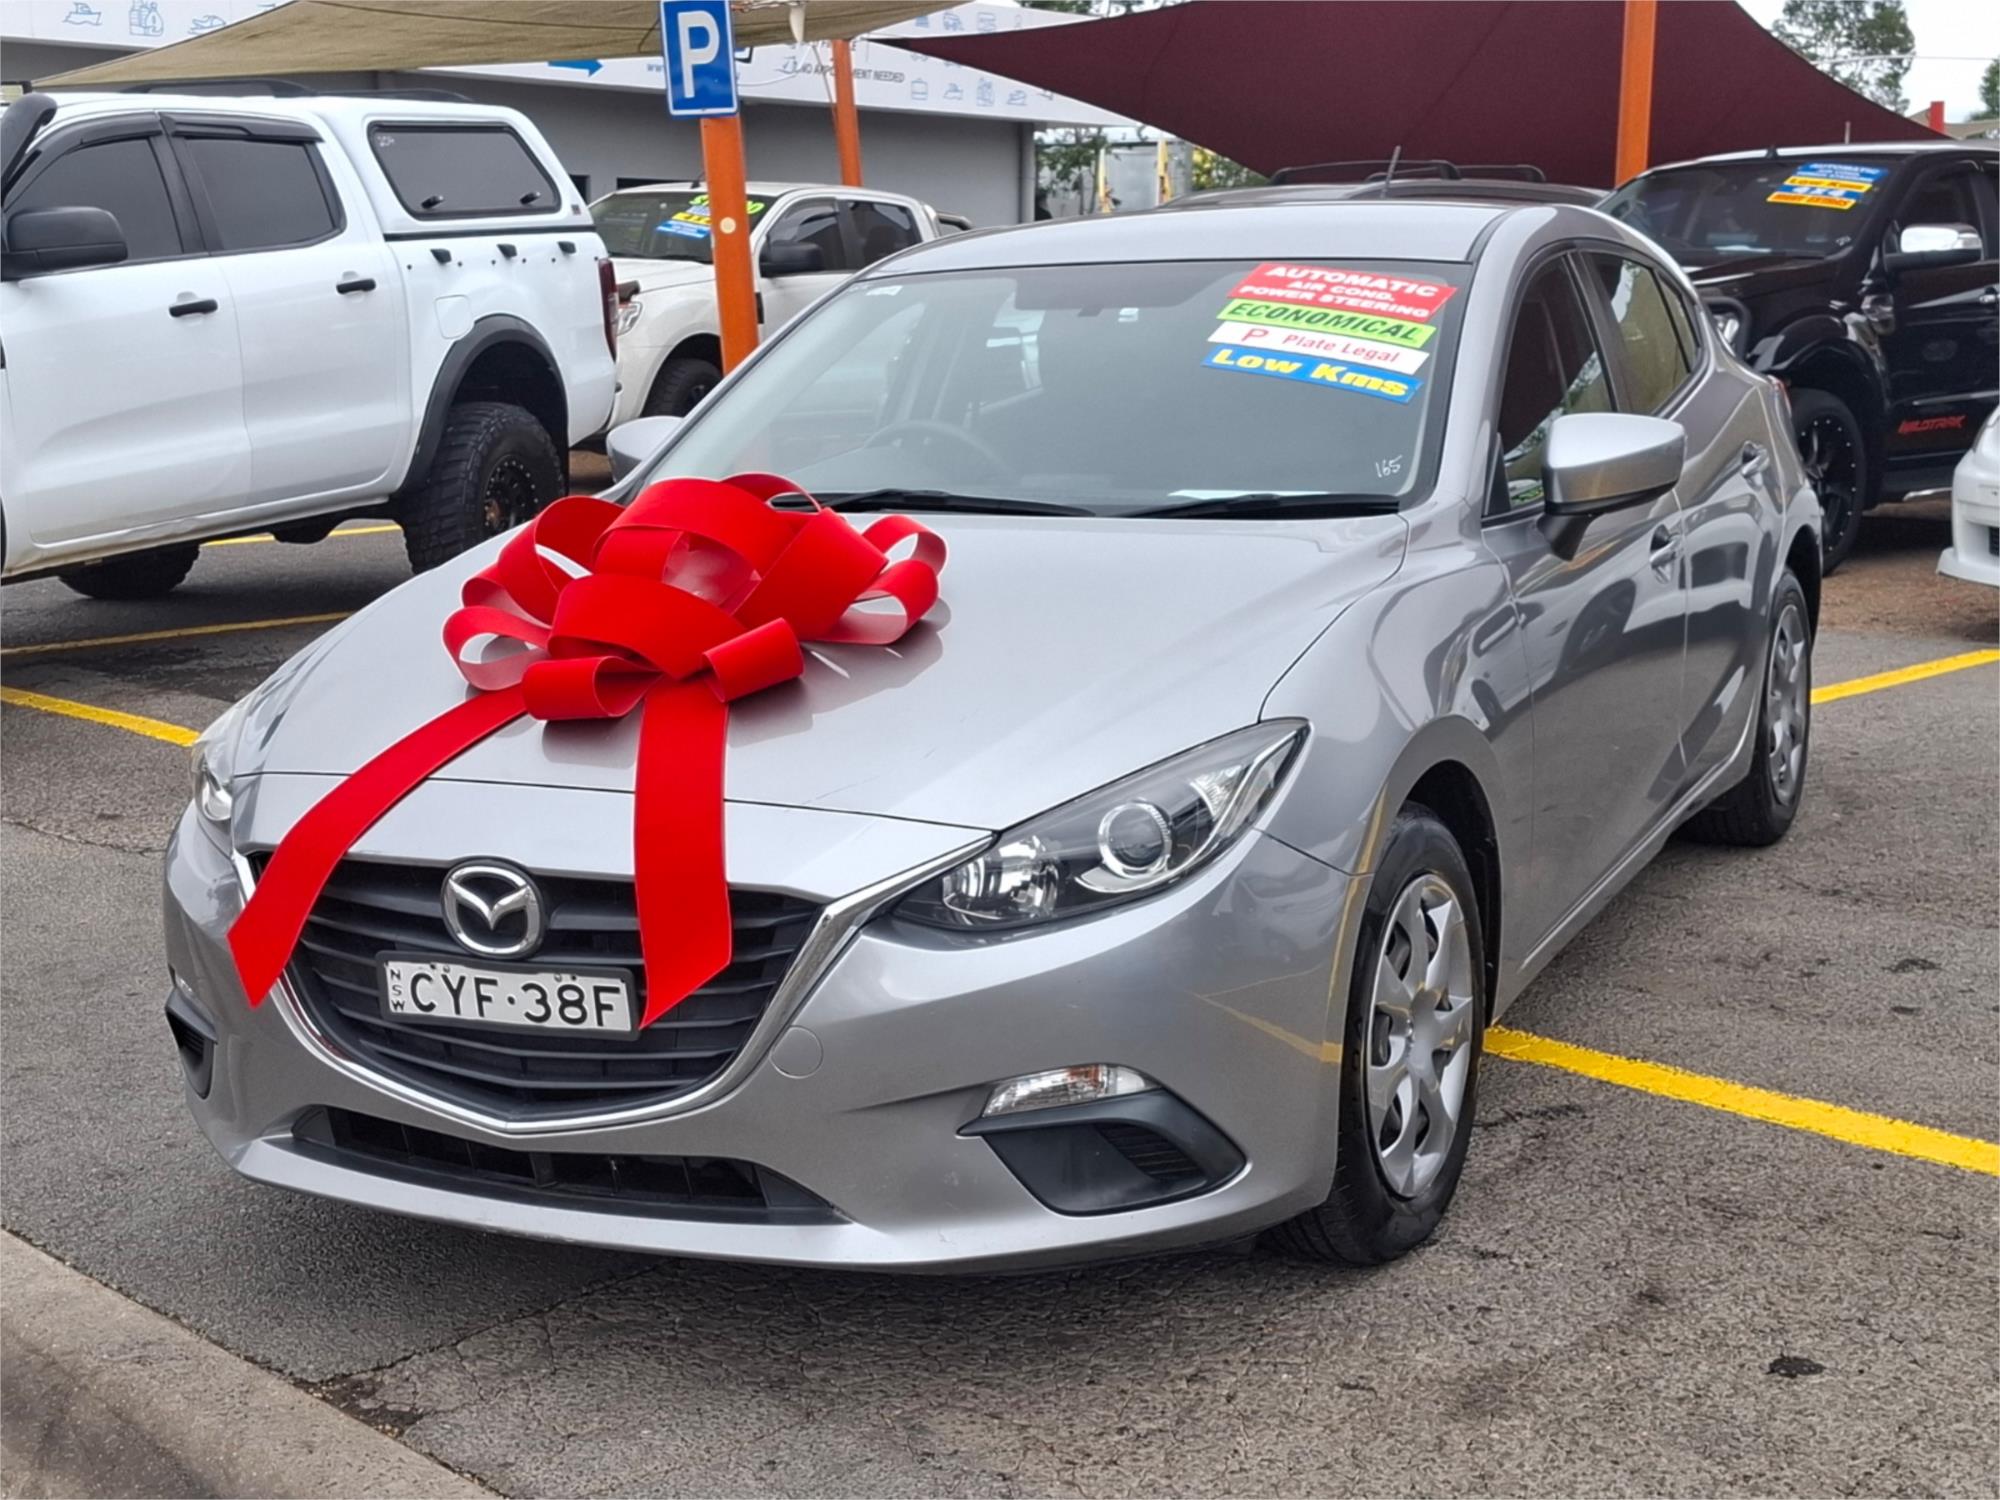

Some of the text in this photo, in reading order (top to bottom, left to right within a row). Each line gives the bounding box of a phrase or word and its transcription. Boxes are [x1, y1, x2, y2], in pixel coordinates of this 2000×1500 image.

[677, 10, 720, 98] P
[1266, 266, 1438, 298] AUTOMATIC
[1287, 280, 1396, 302] AIR COND.
[1239, 285, 1430, 318] POWER STEERING
[1228, 303, 1420, 341] ECONOMICAL
[1241, 327, 1400, 363] P Plate Legal
[1211, 348, 1409, 396] Low Kms
[1375, 454, 1403, 478] 165
